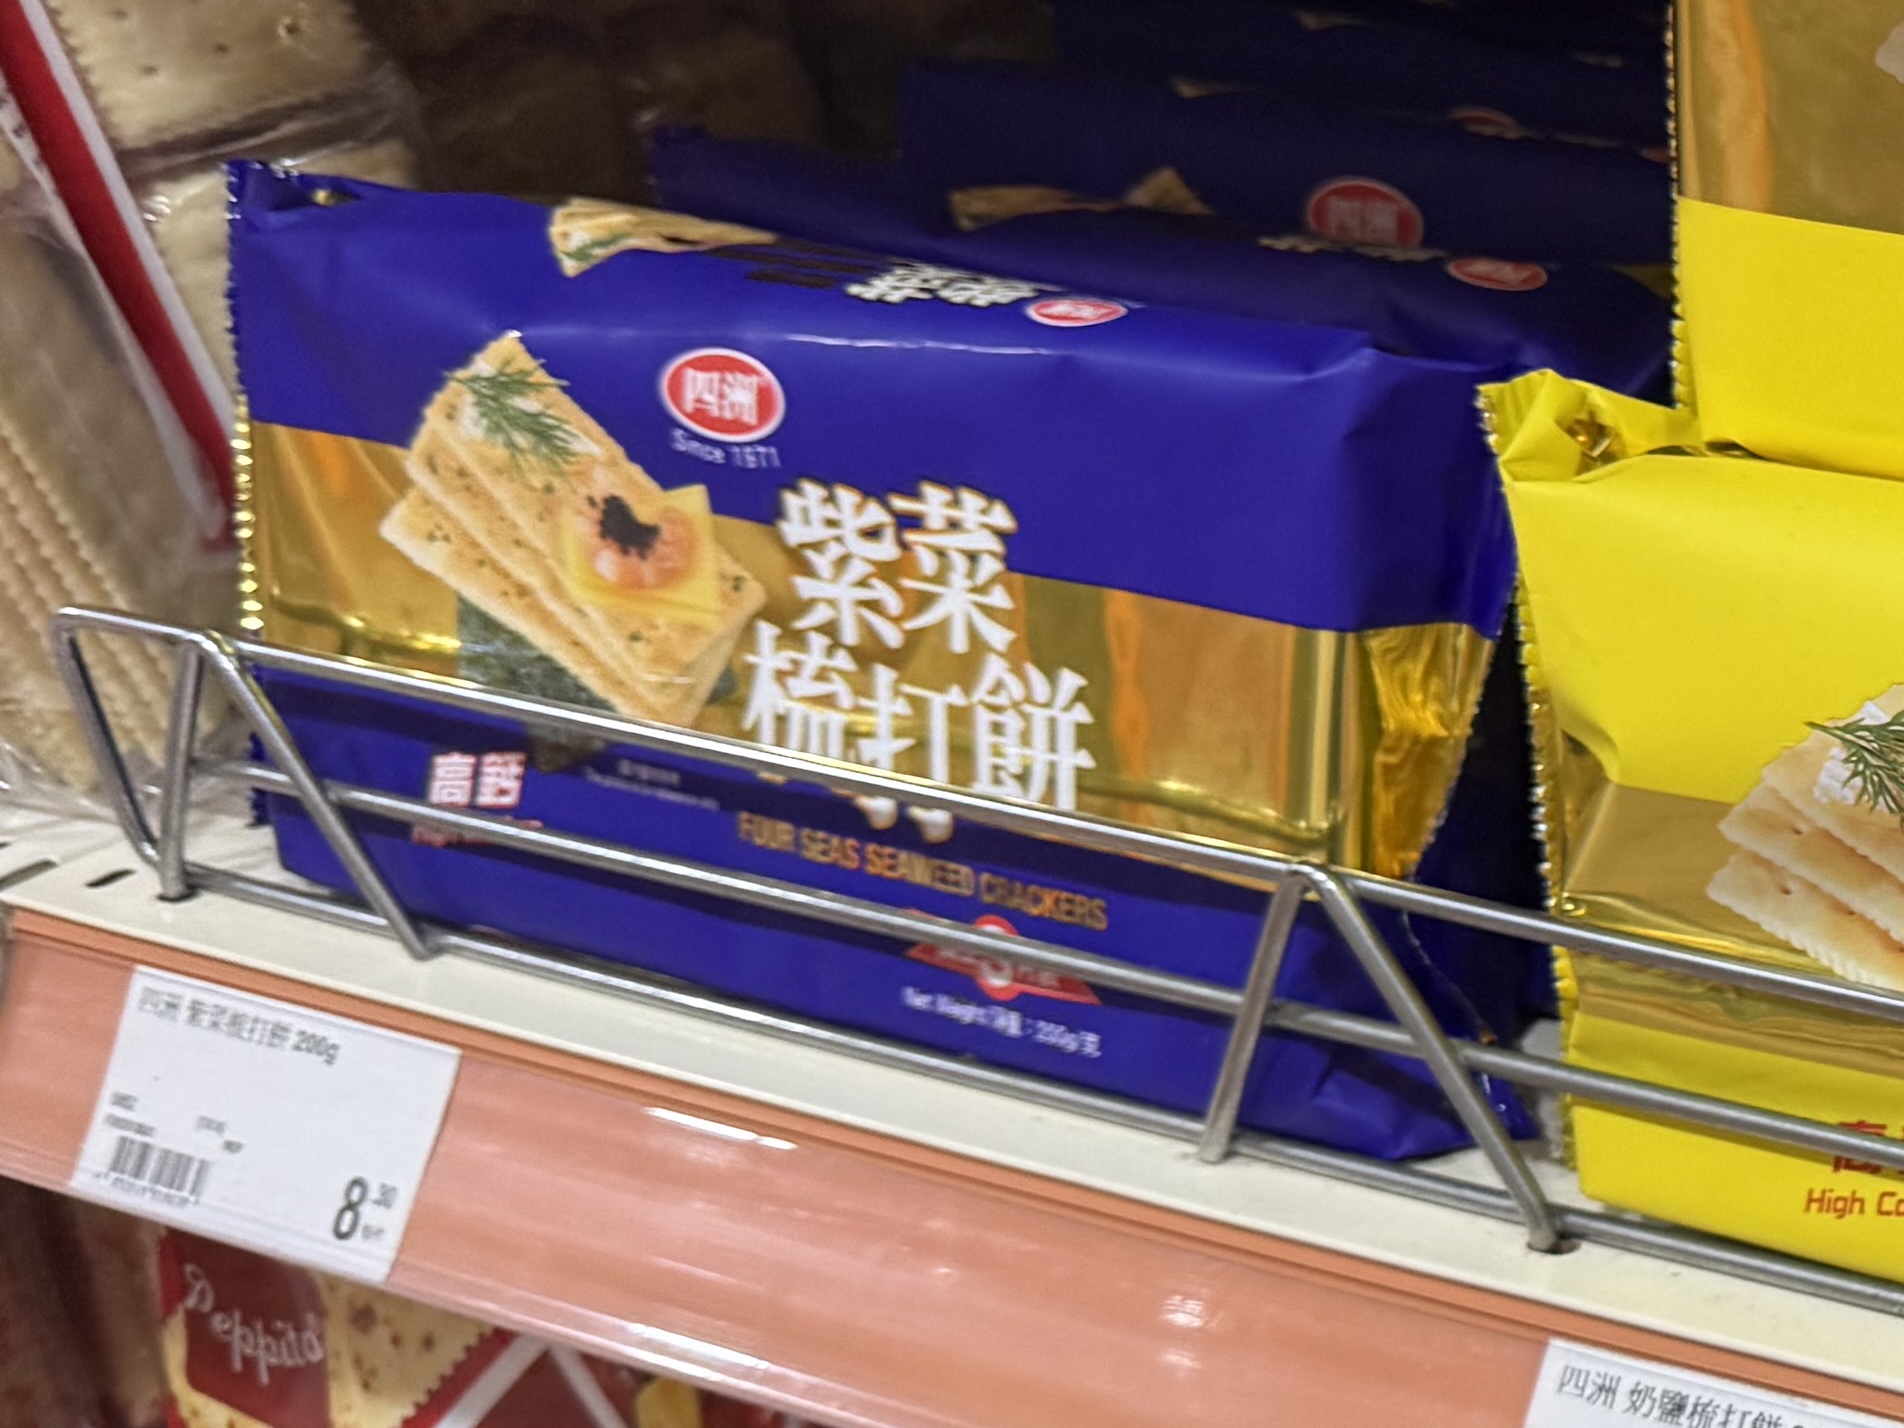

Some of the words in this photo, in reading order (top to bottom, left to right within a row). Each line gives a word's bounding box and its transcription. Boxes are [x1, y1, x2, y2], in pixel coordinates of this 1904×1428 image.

[682, 365, 760, 428] 四洲
[669, 427, 726, 468] Since
[777, 477, 1019, 654] 紫菜
[741, 619, 1099, 844] 梳打餅
[799, 826, 861, 870] SEAS
[978, 872, 1109, 931] CRACKERS
[290, 1029, 341, 1066] 200g
[331, 1176, 369, 1241] 8
[1803, 1188, 1866, 1220] High
[1556, 1362, 1618, 1412] 四洲
